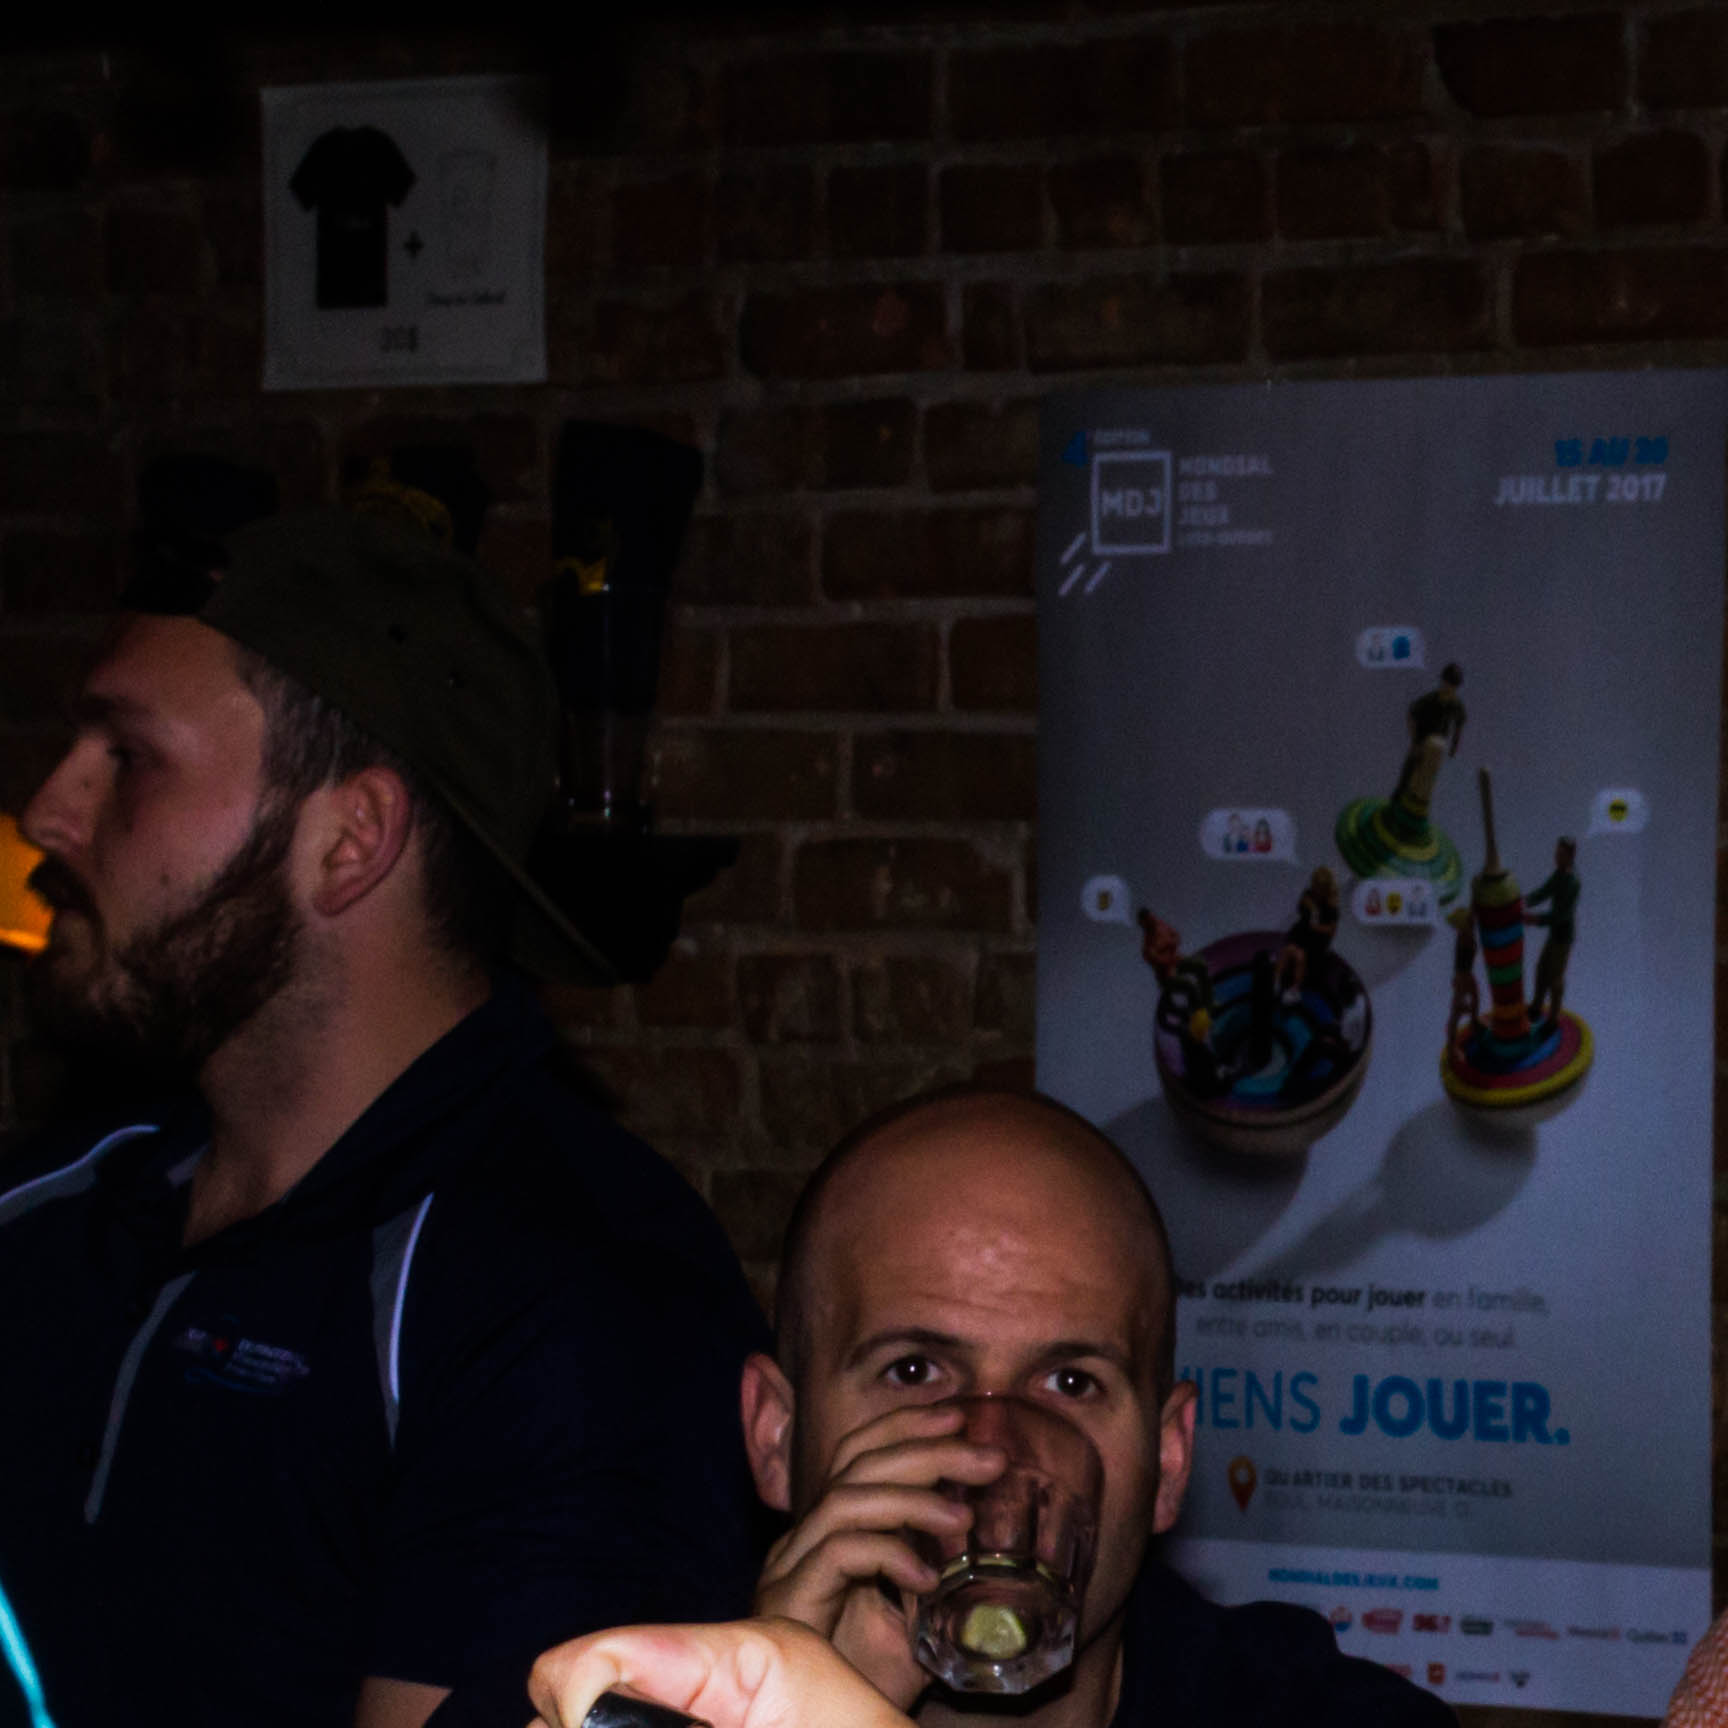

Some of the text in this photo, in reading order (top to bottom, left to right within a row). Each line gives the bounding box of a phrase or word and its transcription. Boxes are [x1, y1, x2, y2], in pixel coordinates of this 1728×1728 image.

[1101, 488, 1162, 517] MDJ
[1494, 471, 1669, 506] JUILLET 2017
[1213, 1276, 1304, 1301] activités
[1311, 1284, 1362, 1308] pour
[1367, 1282, 1428, 1311] jouer
[1180, 1366, 1571, 1446] IENS JOUER.
[1358, 1473, 1393, 1492] DES
